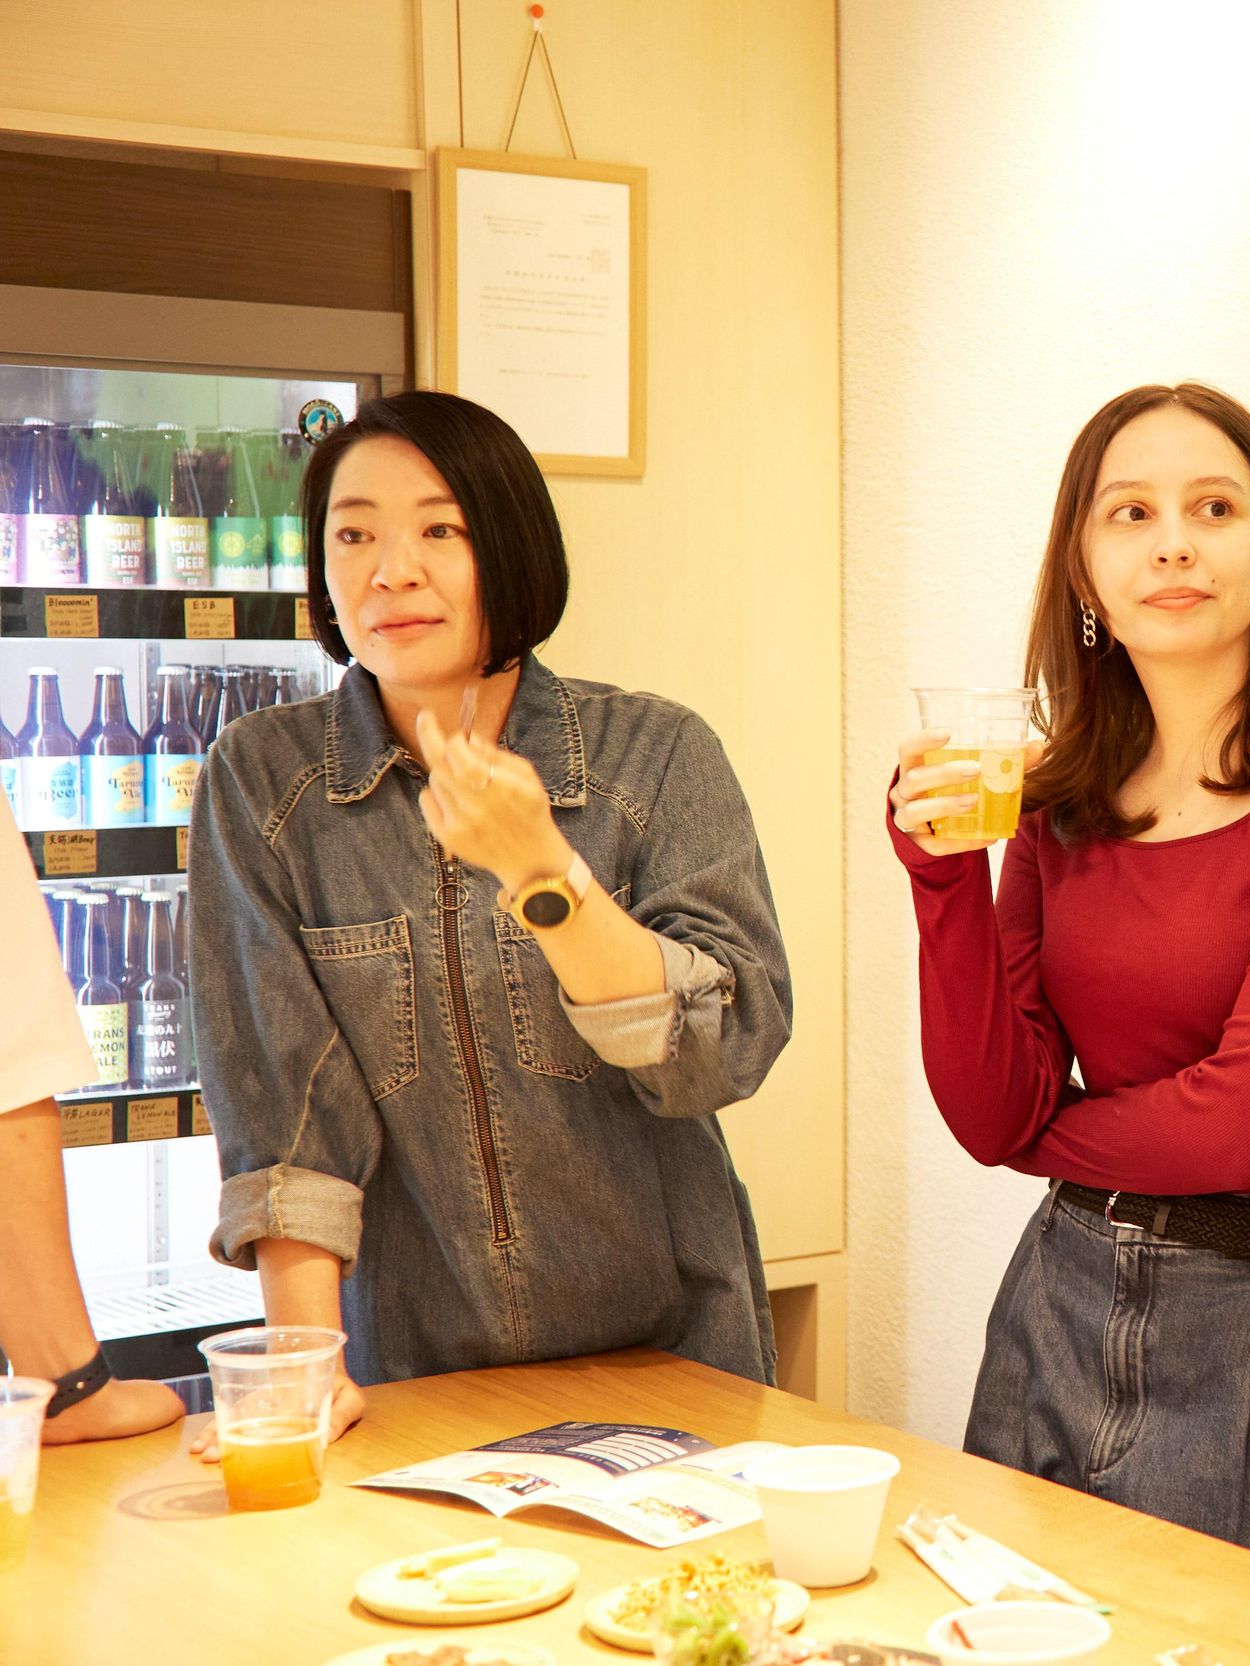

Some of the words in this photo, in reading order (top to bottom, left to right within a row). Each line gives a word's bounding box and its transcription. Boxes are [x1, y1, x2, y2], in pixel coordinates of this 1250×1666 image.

[112, 555, 140, 569] BEER
[177, 556, 205, 569] BEER
[97, 1056, 118, 1067] ALE
